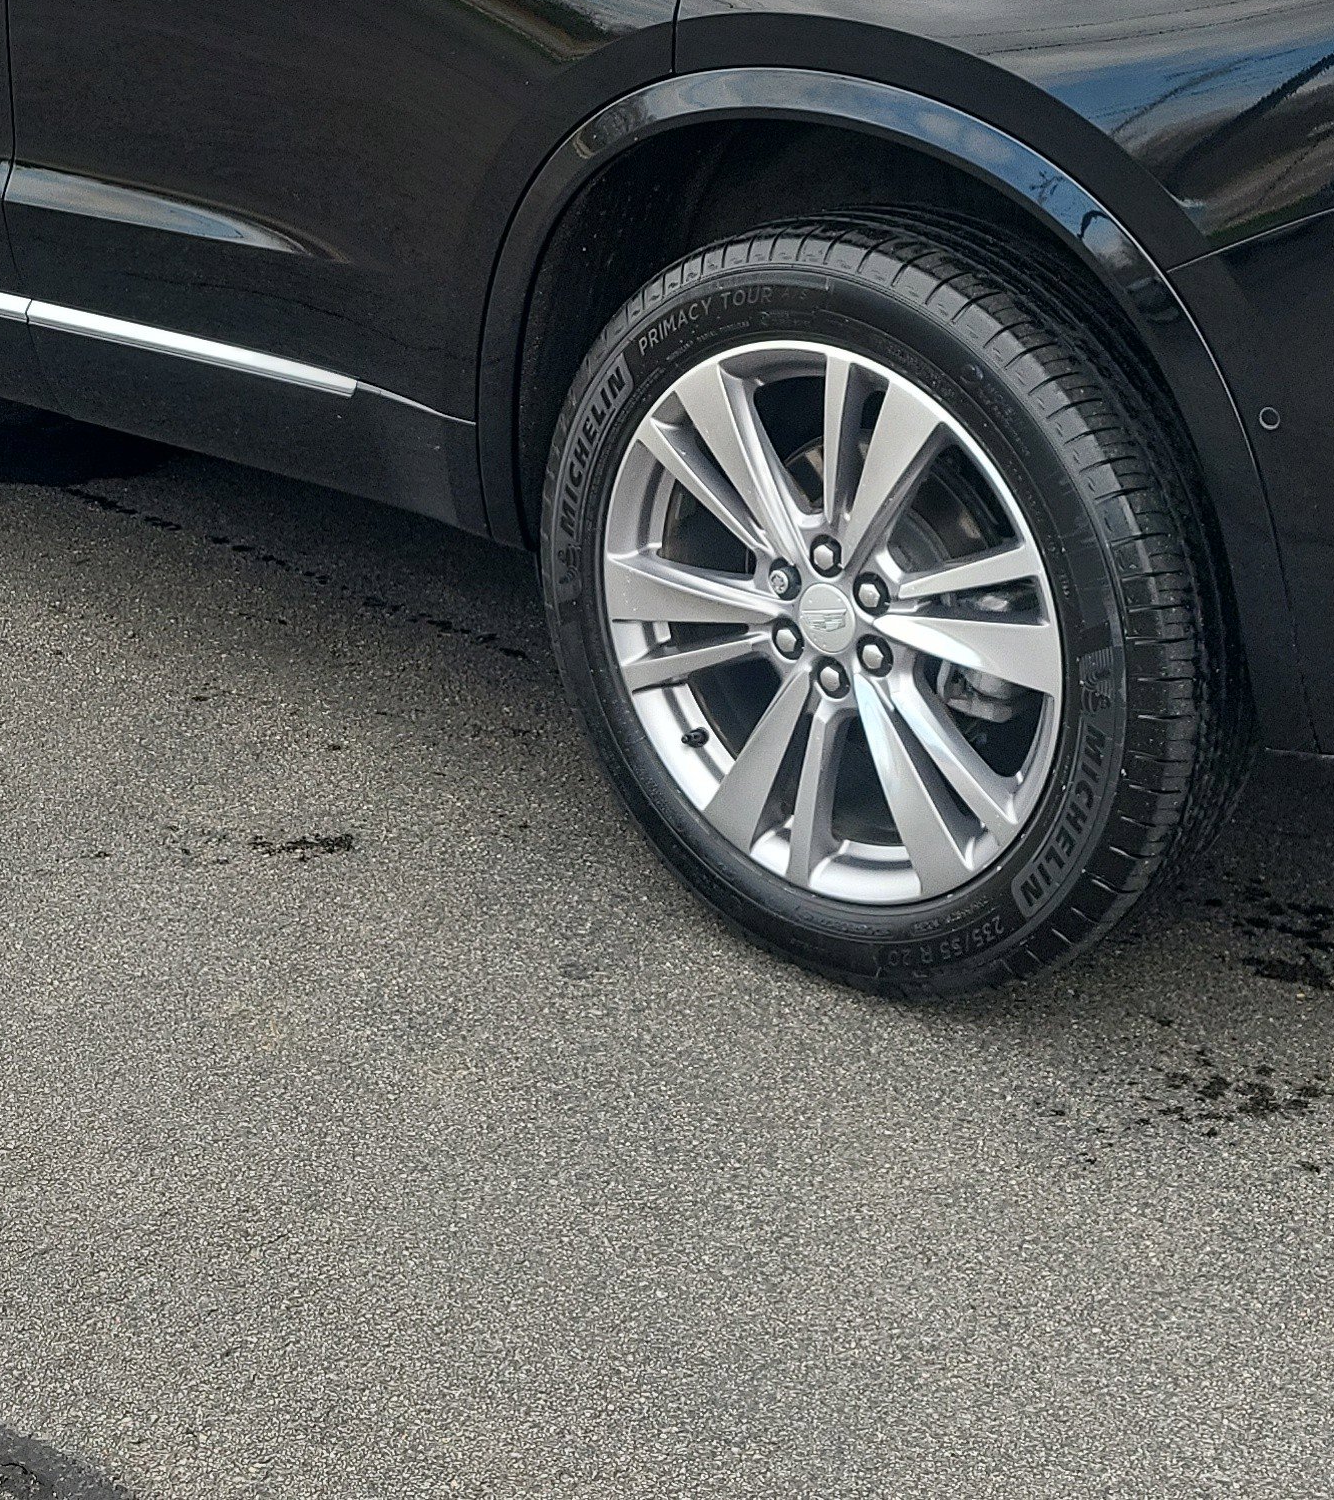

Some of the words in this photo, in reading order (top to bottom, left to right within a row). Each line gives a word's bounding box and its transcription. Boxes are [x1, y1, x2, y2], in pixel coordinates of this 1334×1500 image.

[638, 297, 712, 356] PRIMACY
[720, 287, 773, 311] TOUR
[559, 365, 627, 540] MICHELIN
[1020, 723, 1107, 908] MICHELIN
